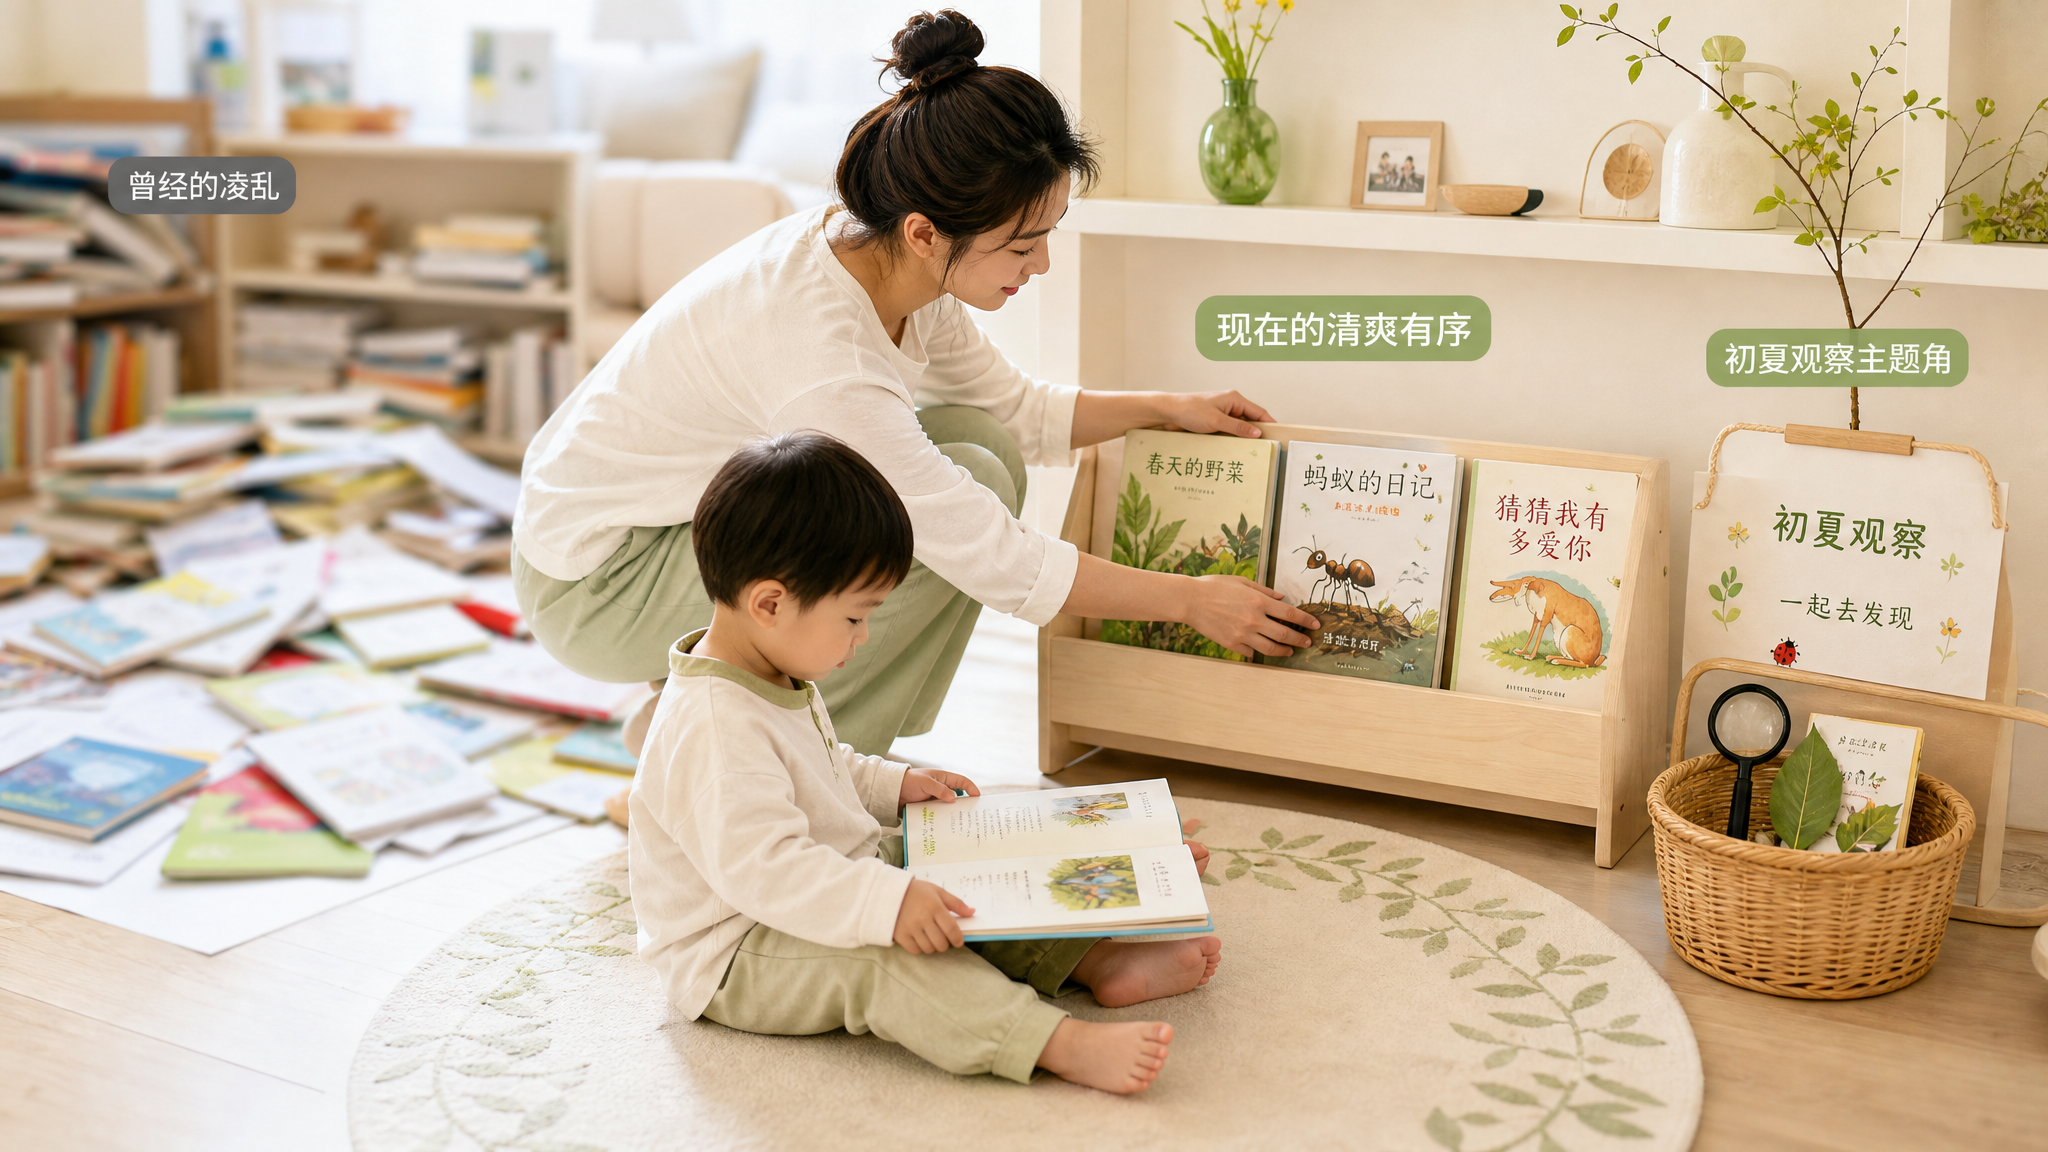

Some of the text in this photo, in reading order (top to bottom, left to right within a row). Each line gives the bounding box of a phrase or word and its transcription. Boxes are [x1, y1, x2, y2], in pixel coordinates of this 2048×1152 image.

[1146, 452, 1243, 483] 春天的野菜
[1303, 464, 1435, 499] 蚂蚁的日记
[1495, 494, 1608, 532] 猜猜我有
[1772, 503, 1926, 559] 初夏观察
[1509, 528, 1591, 561] 多爱你
[1780, 593, 1913, 631] 一起去发现
